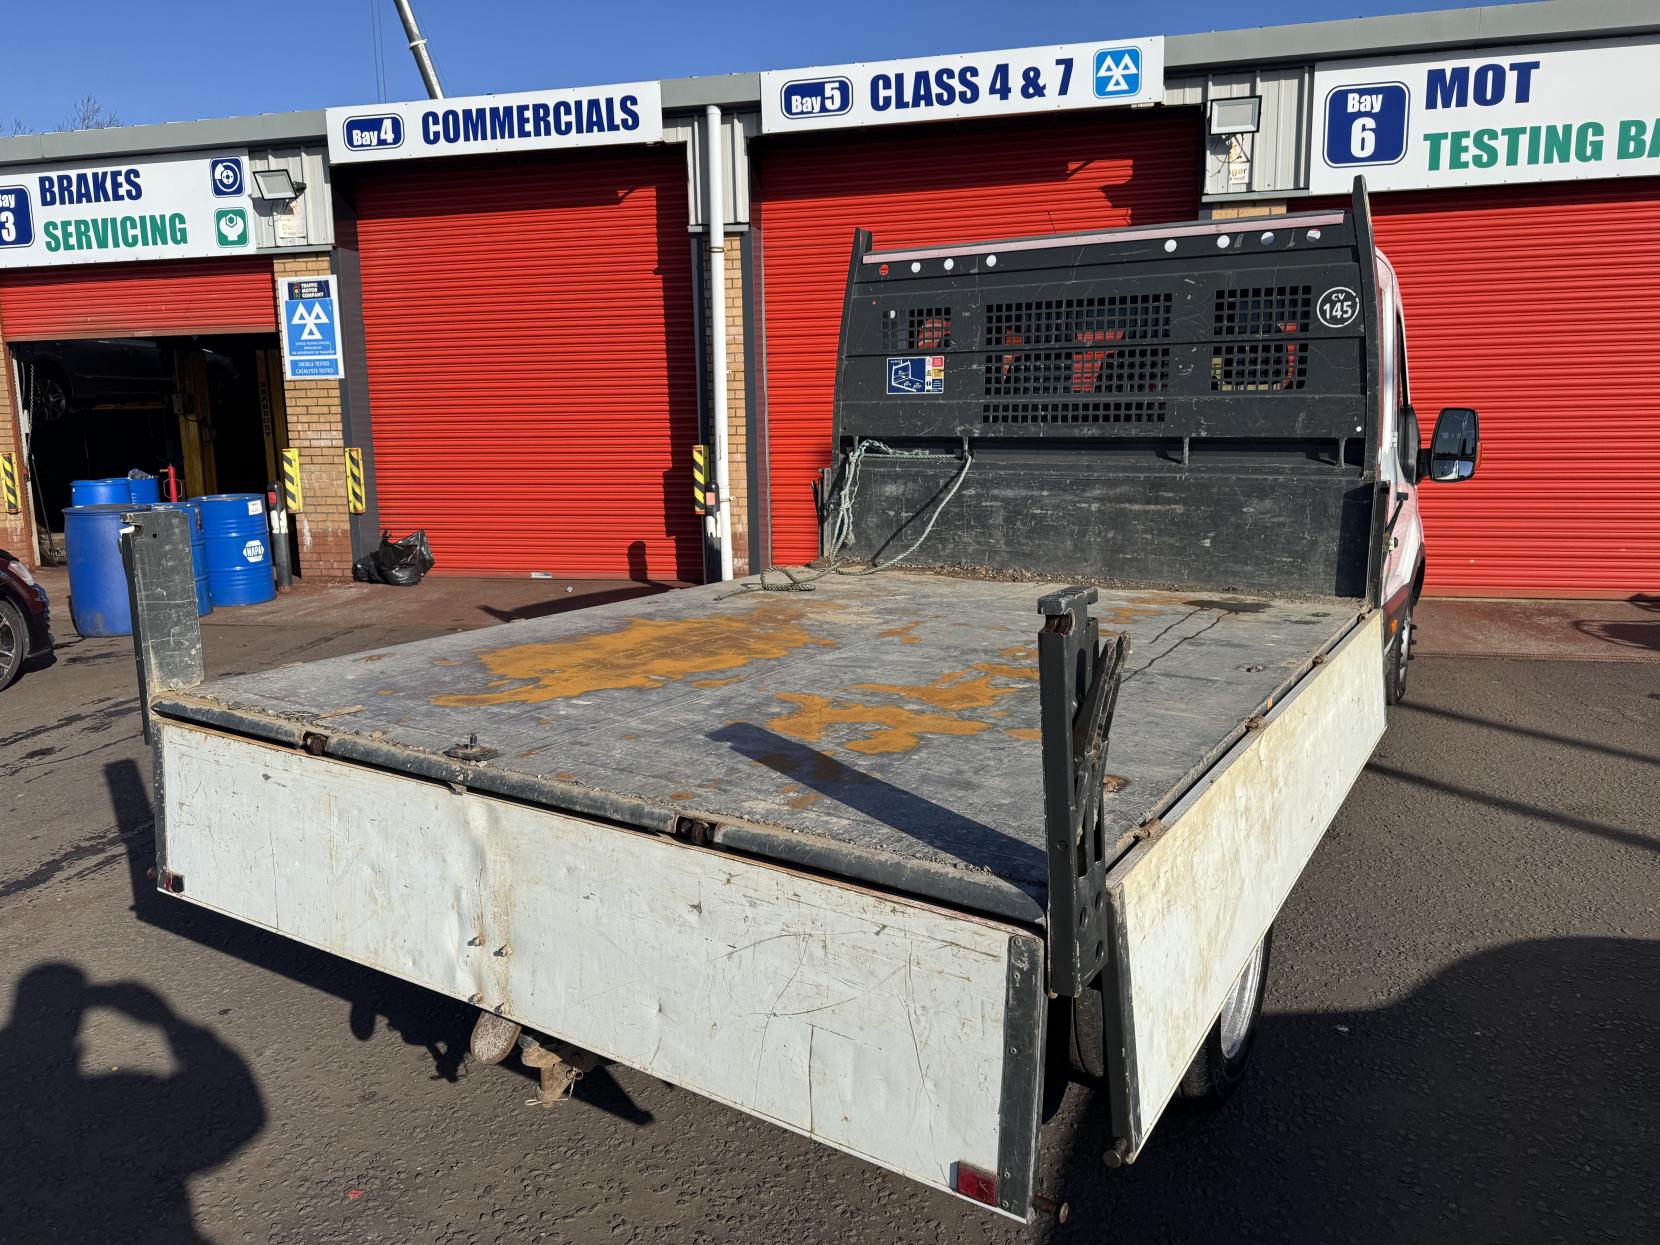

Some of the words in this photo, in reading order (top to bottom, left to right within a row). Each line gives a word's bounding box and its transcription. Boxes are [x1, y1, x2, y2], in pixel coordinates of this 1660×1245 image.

[790, 95, 823, 116] Bay
[825, 83, 843, 111] 5
[871, 66, 980, 111] CLASS
[989, 63, 1011, 101] 4
[1020, 66, 1047, 99] &
[1055, 58, 1074, 96] 7
[1425, 61, 1540, 110] MOT
[421, 95, 640, 145] COMMERCIALS
[1347, 92, 1383, 114] Bay
[352, 127, 378, 148] Bay
[379, 118, 395, 145] 4
[1350, 116, 1376, 158] 6
[1423, 122, 1605, 172] TESTING
[0, 193, 16, 209] ay
[39, 168, 142, 207] BRAKES
[0, 211, 17, 242] 3
[43, 212, 188, 253] SERVICING
[1323, 302, 1352, 319] 145
[1331, 292, 1346, 301] CV
